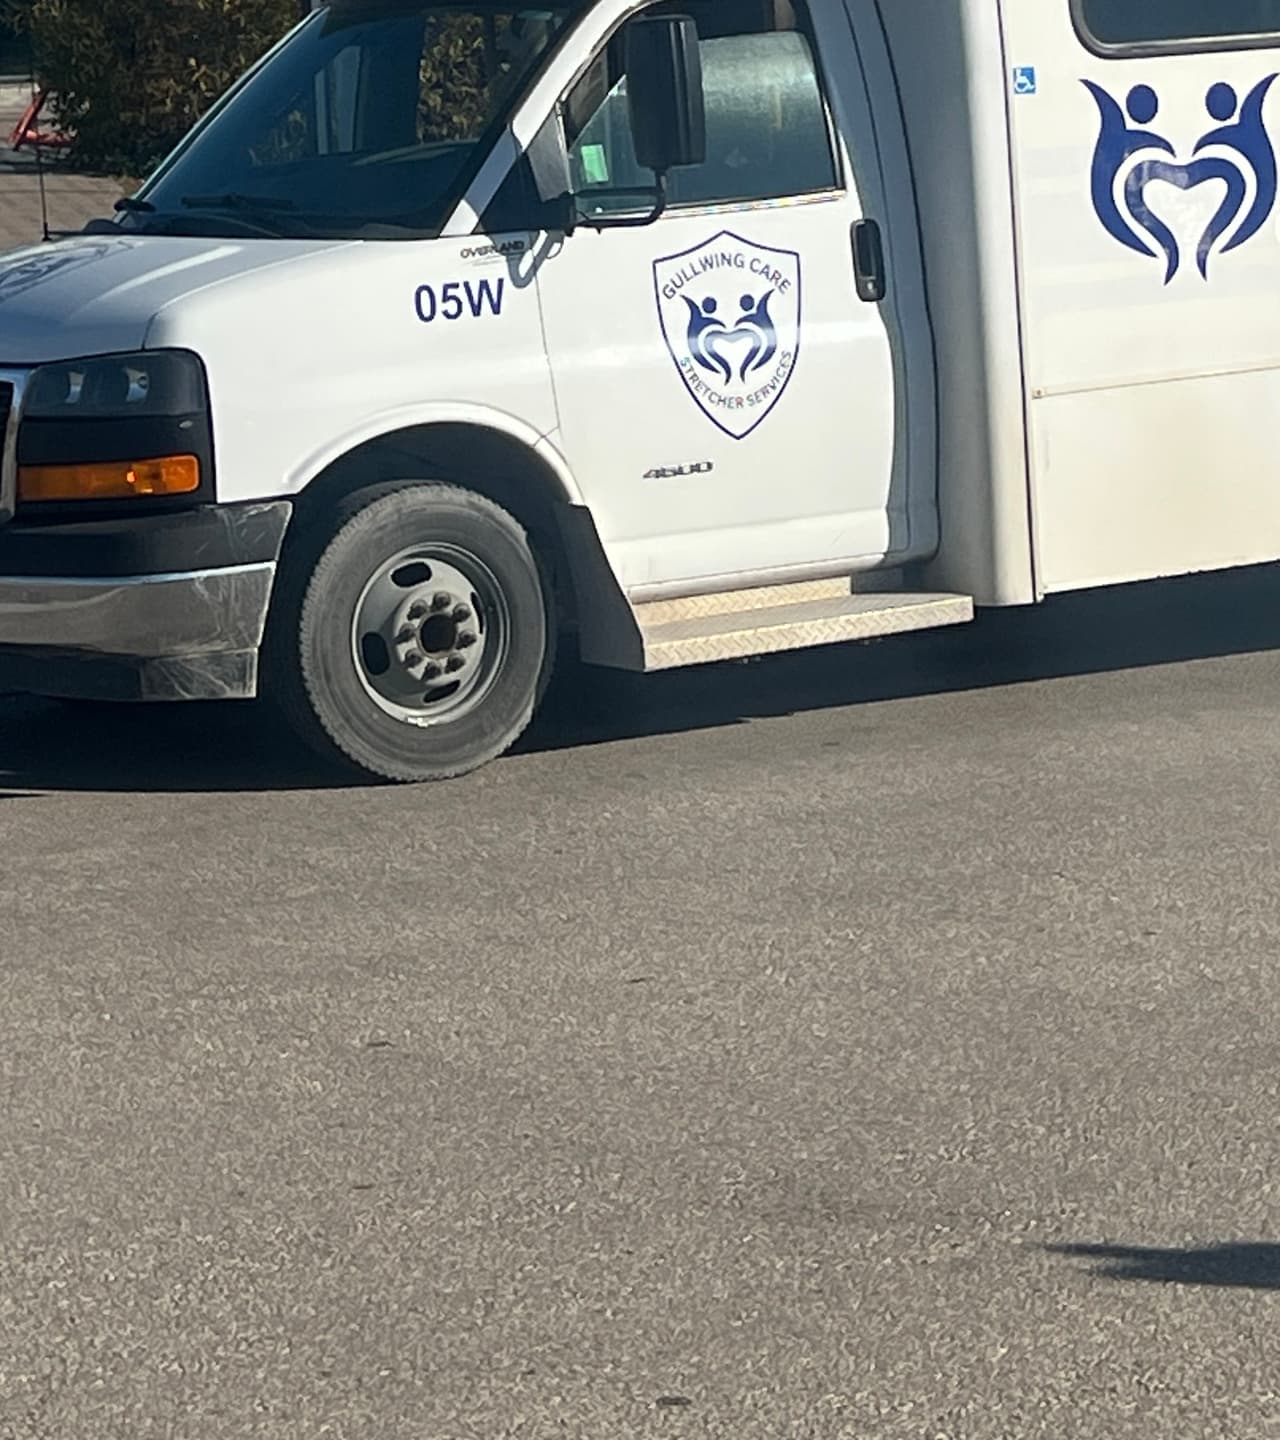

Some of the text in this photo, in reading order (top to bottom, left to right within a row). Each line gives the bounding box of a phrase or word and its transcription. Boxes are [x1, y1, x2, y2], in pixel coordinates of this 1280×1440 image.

[414, 277, 505, 323] 05W
[662, 252, 792, 300] GULLWING CARE
[680, 350, 792, 410] STRETCHER SERVICES
